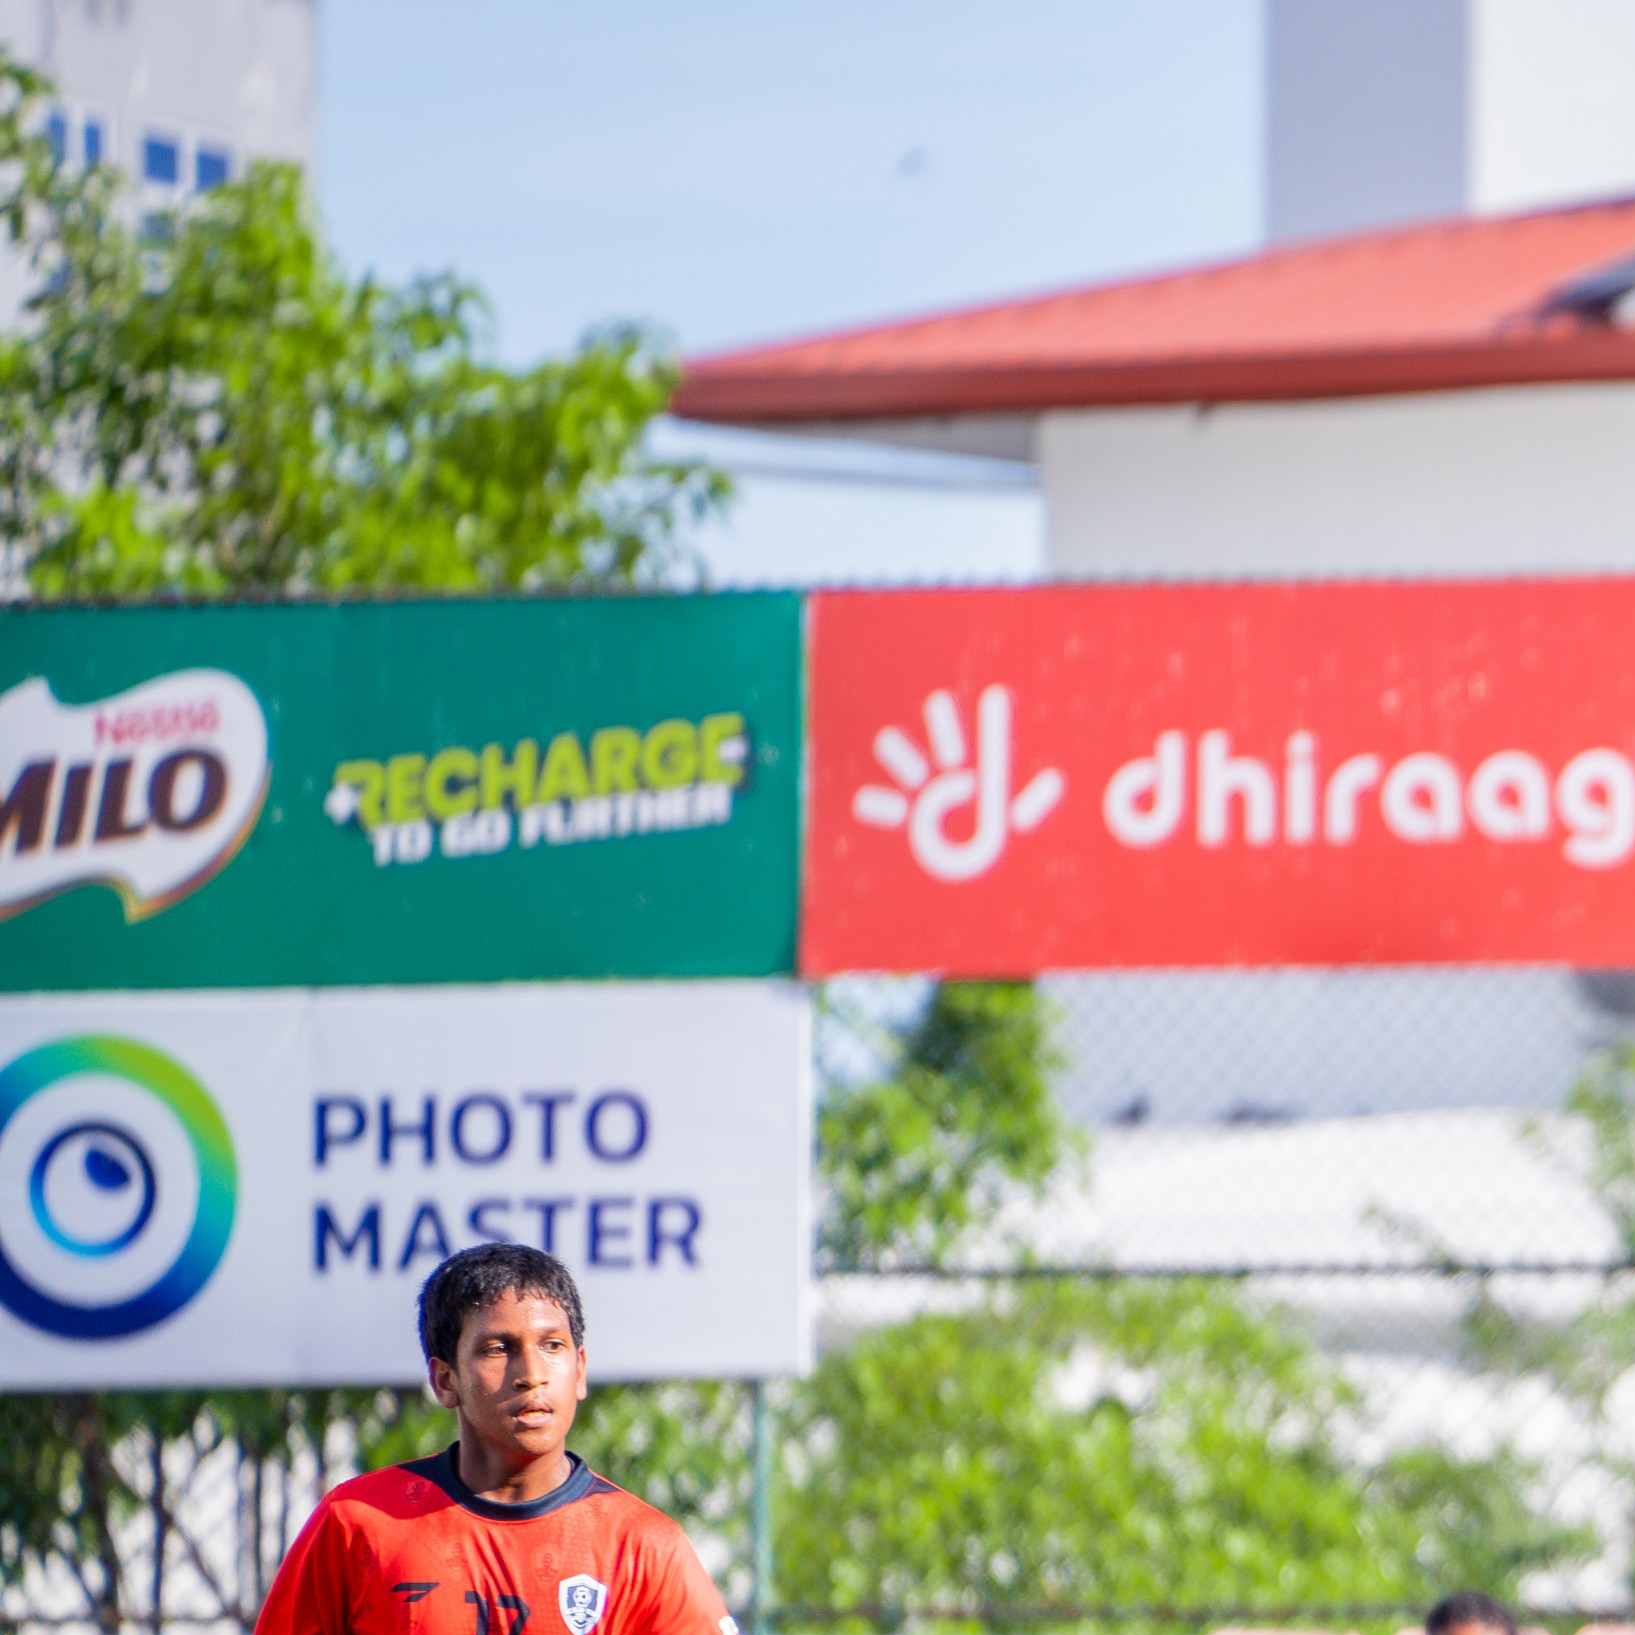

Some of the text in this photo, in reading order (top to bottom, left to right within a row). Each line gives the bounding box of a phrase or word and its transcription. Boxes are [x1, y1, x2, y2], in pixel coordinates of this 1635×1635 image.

[333, 712, 743, 829] RECHARGE
[313, 1089, 650, 1167] PHOTO
[314, 1196, 704, 1271] MASTER
